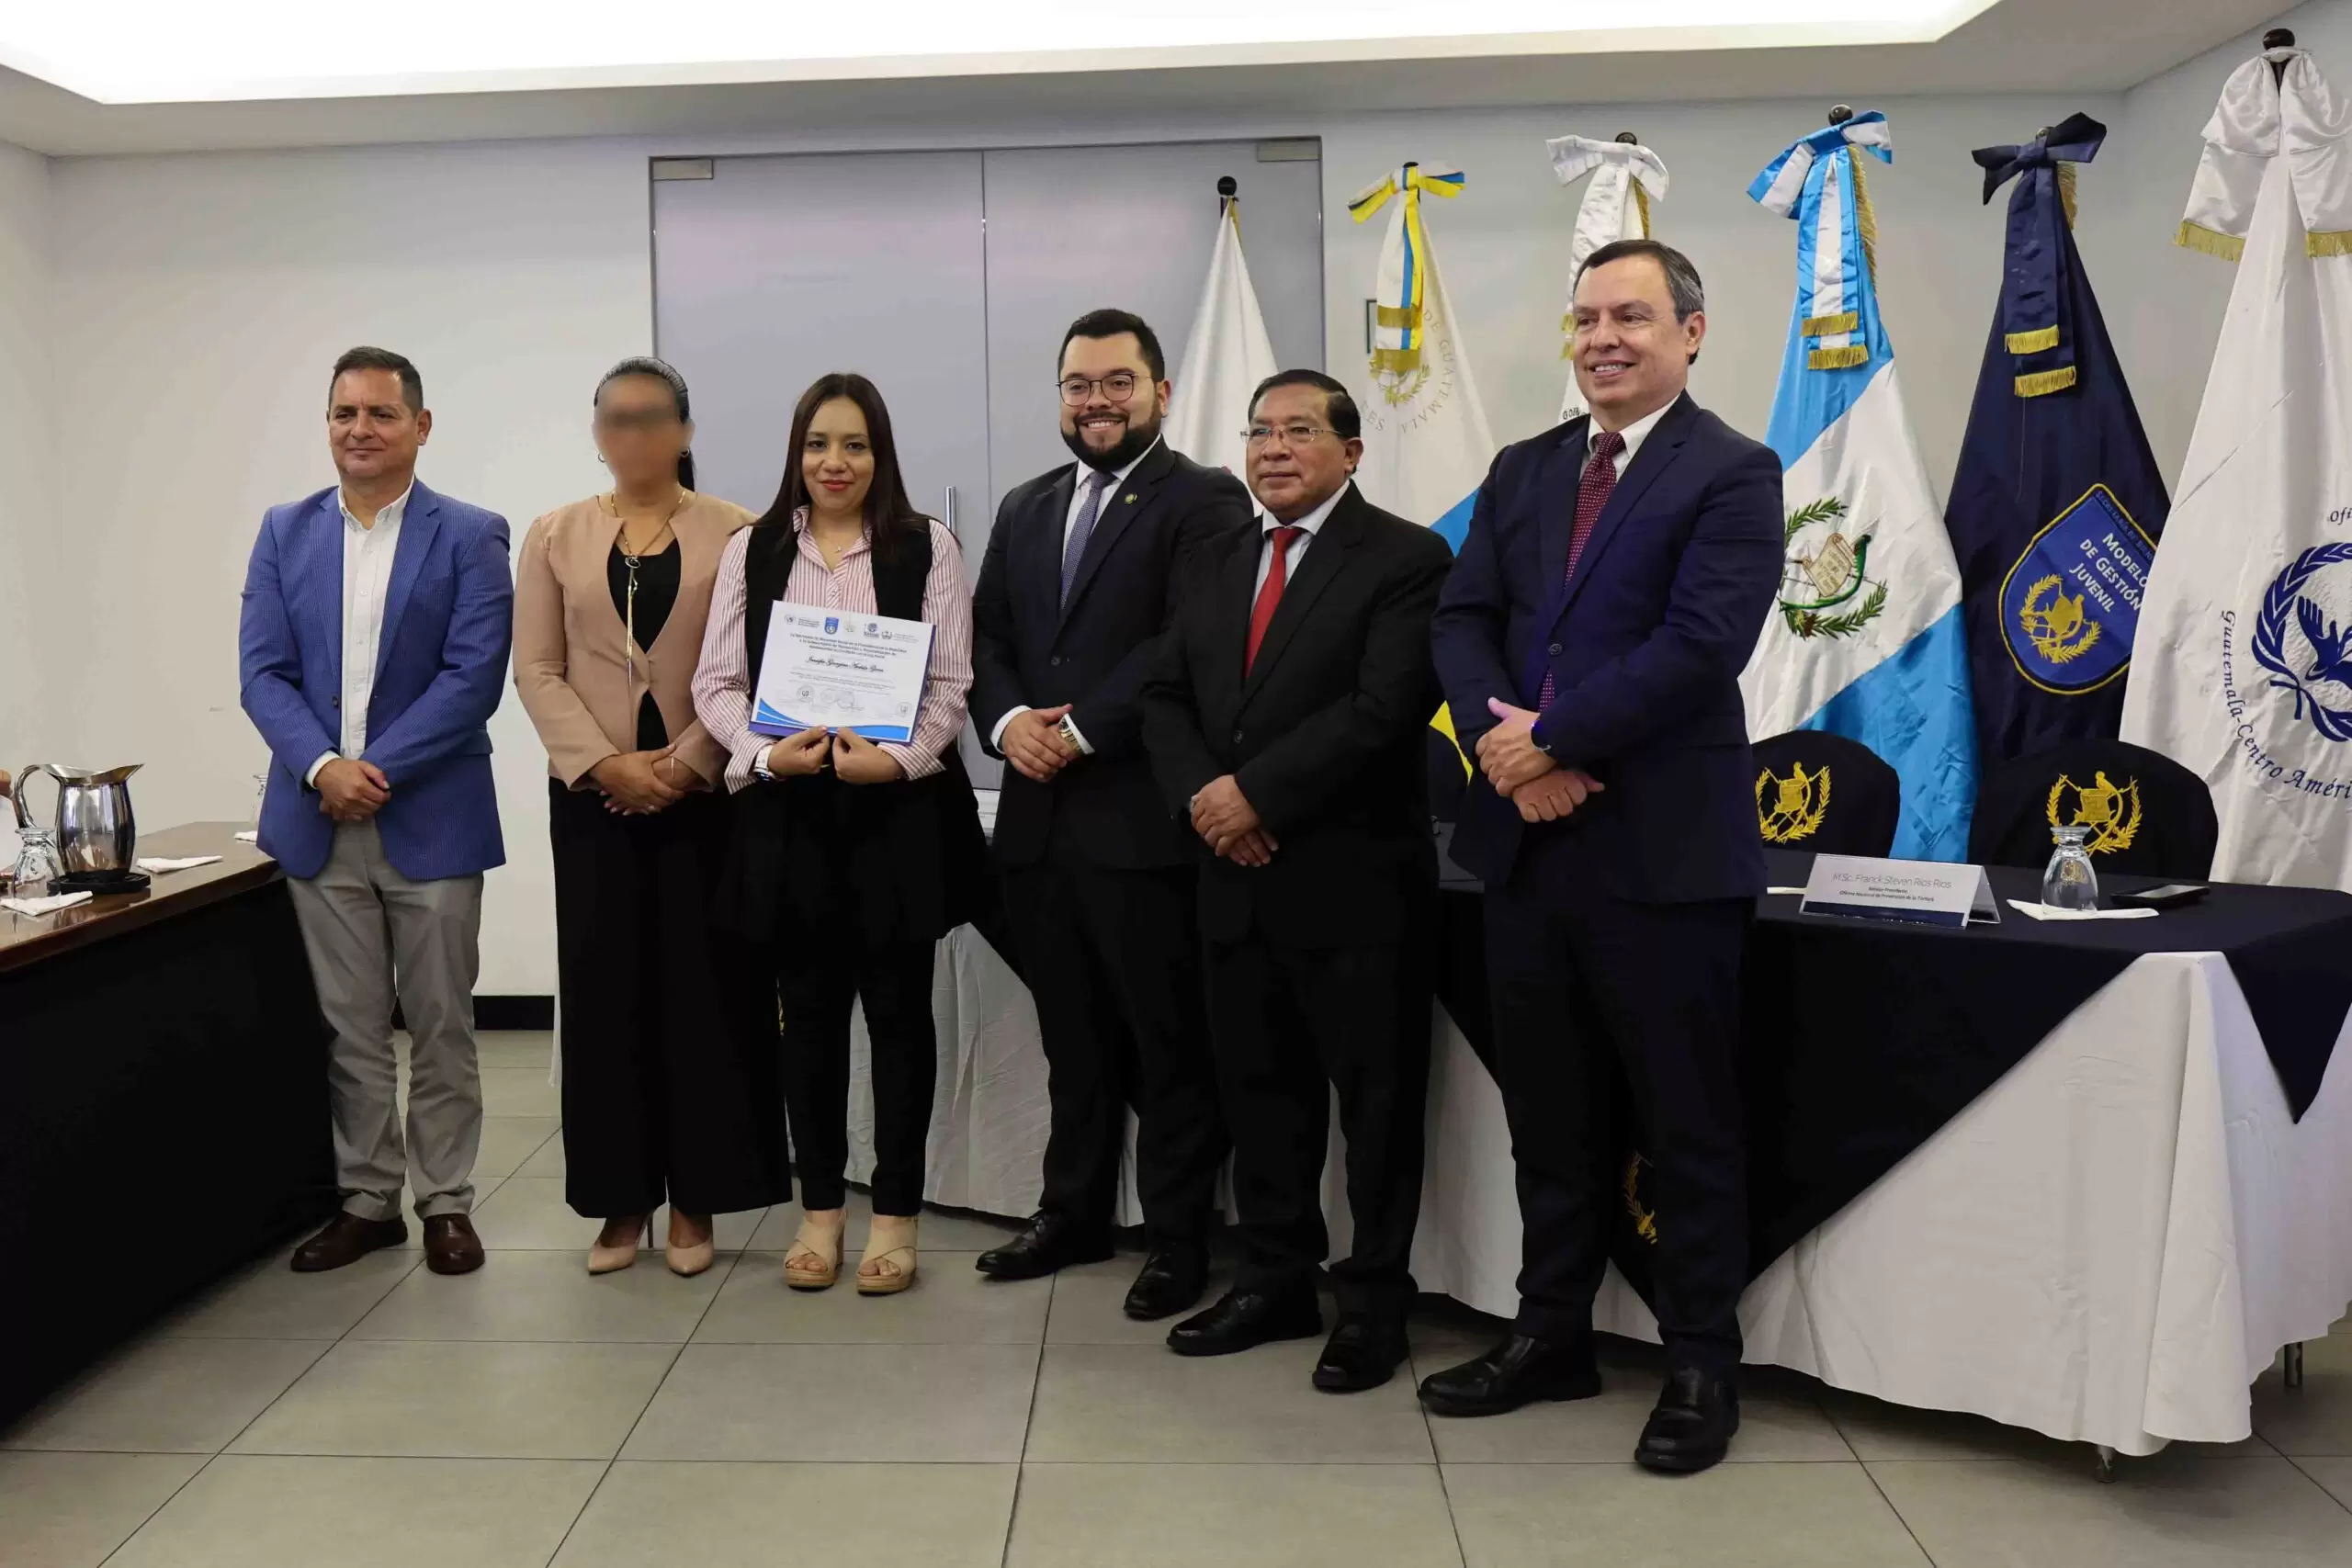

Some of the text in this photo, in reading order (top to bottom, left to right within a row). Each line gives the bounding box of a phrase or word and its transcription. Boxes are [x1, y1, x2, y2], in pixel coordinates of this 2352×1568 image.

[1401, 339, 1455, 434] GUATEMALA
[2069, 561, 2115, 613] JUVENIL
[2080, 538, 2143, 611] DE GESTIÓN
[2102, 532, 2148, 588] MODELO
